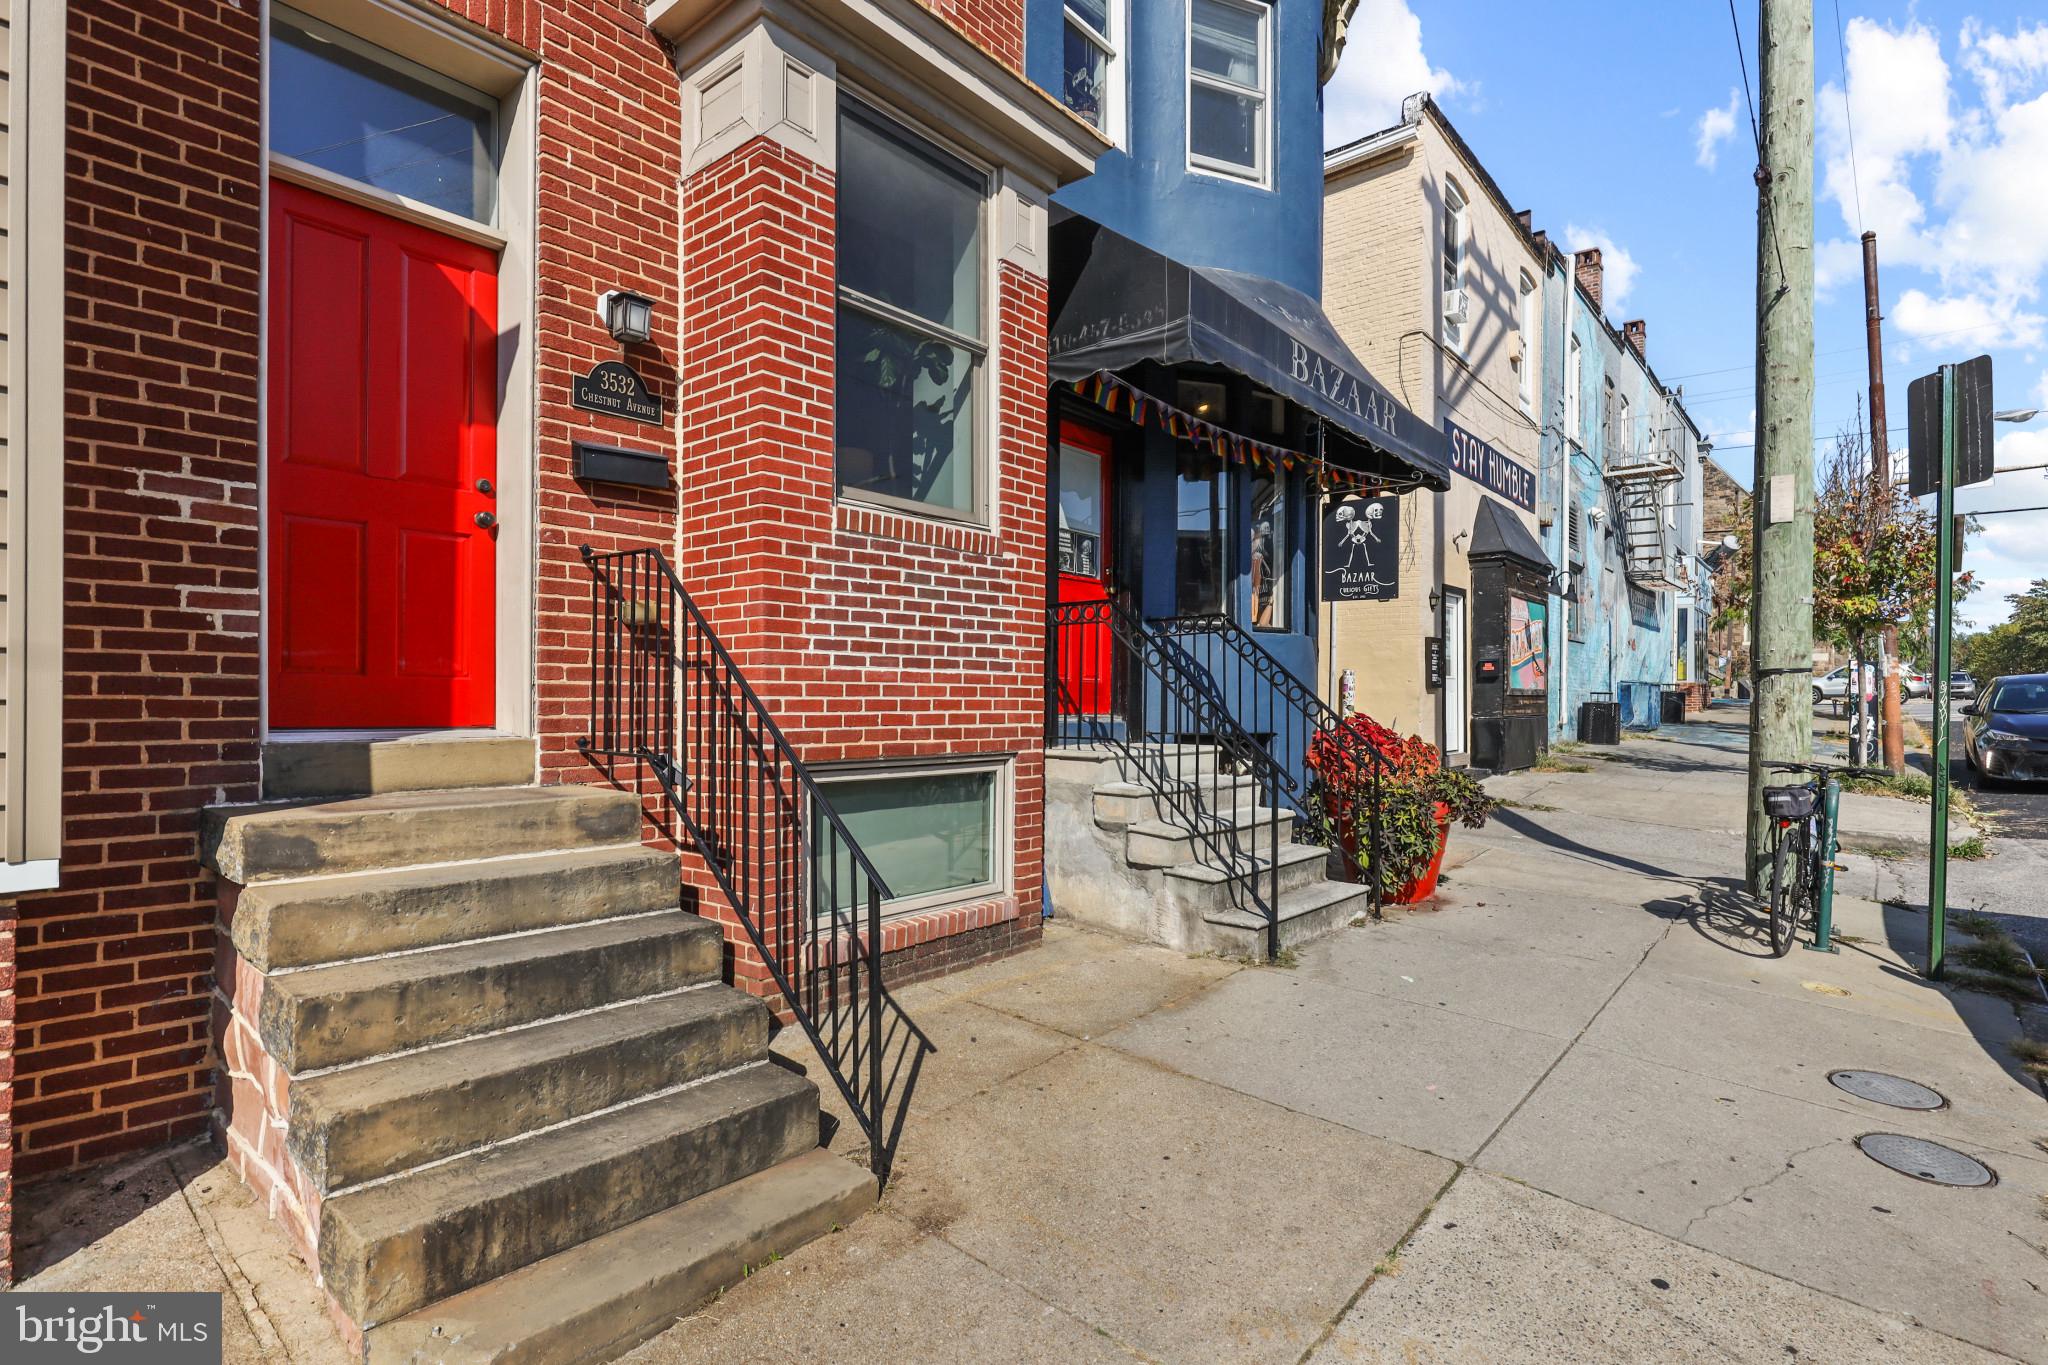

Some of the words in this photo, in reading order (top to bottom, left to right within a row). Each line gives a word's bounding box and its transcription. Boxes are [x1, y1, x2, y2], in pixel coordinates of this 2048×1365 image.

[600, 370, 635, 396] 3532
[1290, 337, 1397, 437] BAZAAR
[581, 387, 621, 409] CHESTNUT
[626, 398, 656, 416] AVENUE
[1452, 428, 1485, 480] STAY
[1488, 450, 1530, 507] HUMBLE
[1341, 571, 1376, 583] BAZAAR
